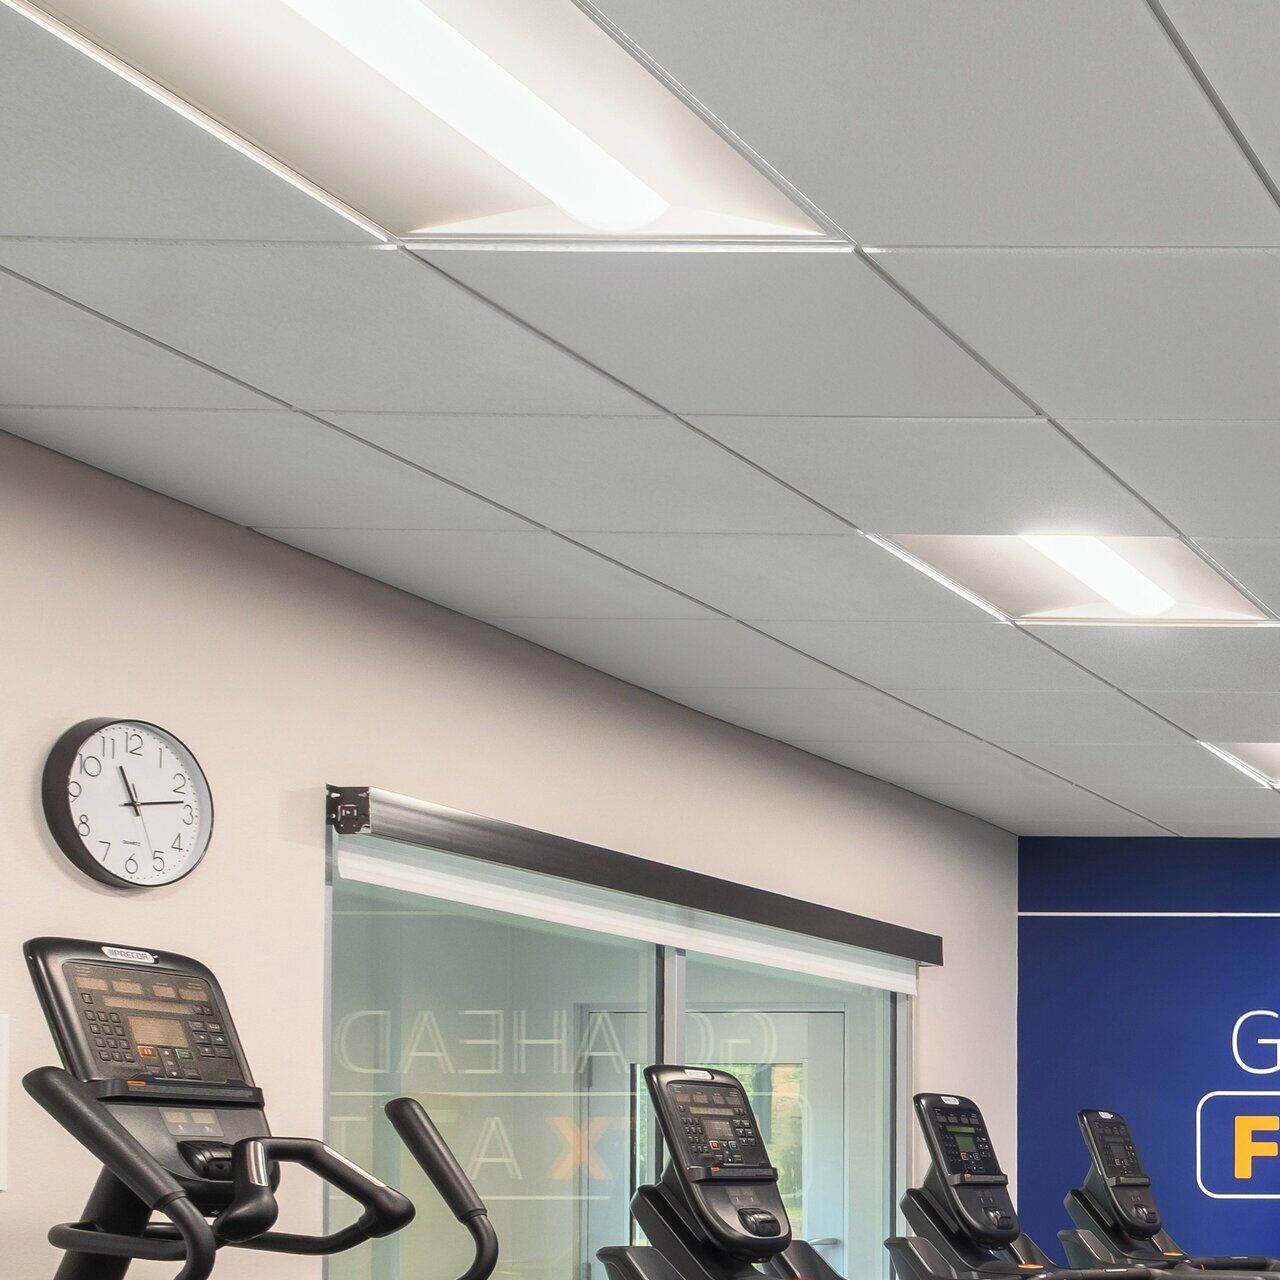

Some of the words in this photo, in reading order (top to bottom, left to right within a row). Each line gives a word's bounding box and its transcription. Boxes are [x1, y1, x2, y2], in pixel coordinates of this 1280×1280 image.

[101, 736, 115, 759] 11
[125, 732, 144, 756] 12
[78, 753, 102, 777] 10
[68, 781, 82, 802] 9
[172, 773, 186, 794] 2
[78, 814, 90, 836] 8
[182, 804, 194, 825] 3
[98, 841, 111, 861] 7
[171, 833, 183, 851] 4
[125, 853, 138, 874] 6
[152, 850, 165, 871] 5
